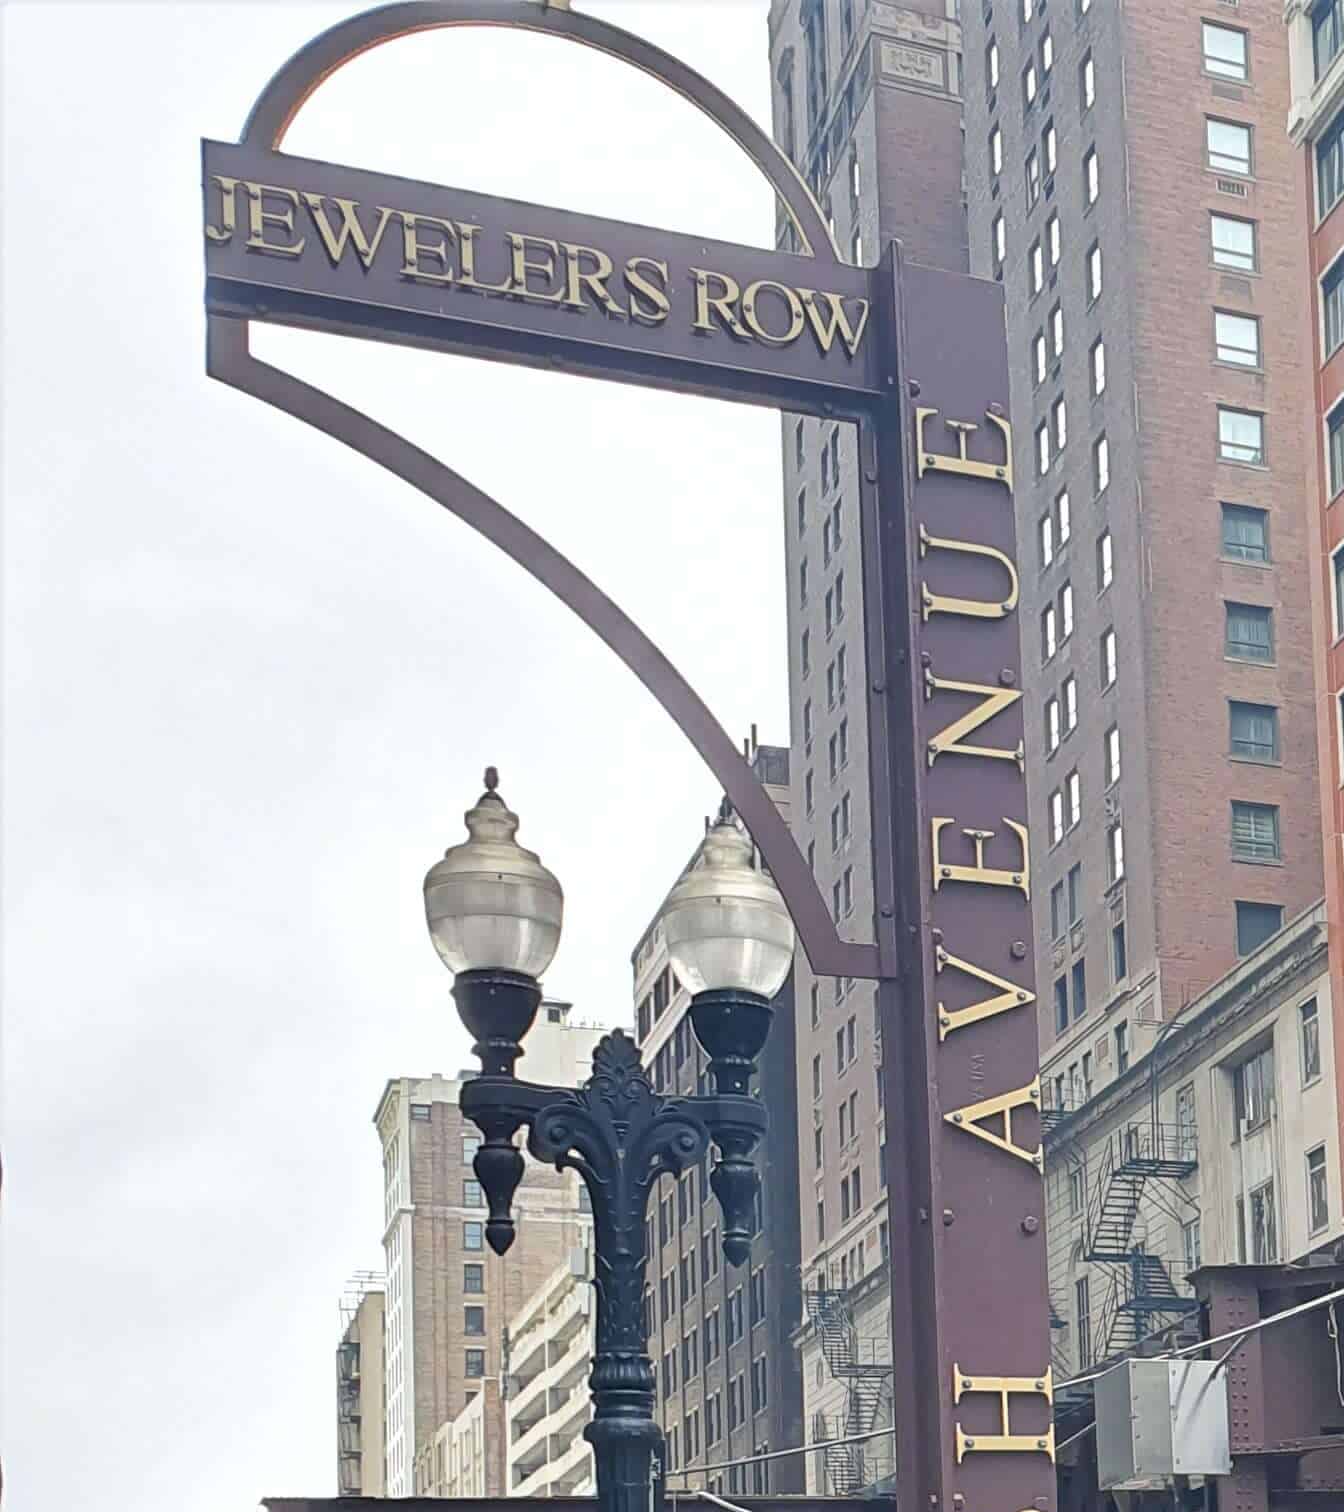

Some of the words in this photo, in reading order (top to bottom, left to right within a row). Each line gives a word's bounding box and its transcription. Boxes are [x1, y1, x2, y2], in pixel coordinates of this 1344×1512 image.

[206, 175, 670, 323] JEWELERS
[689, 267, 869, 358] ROW
[915, 408, 1044, 1174] AVENUE
